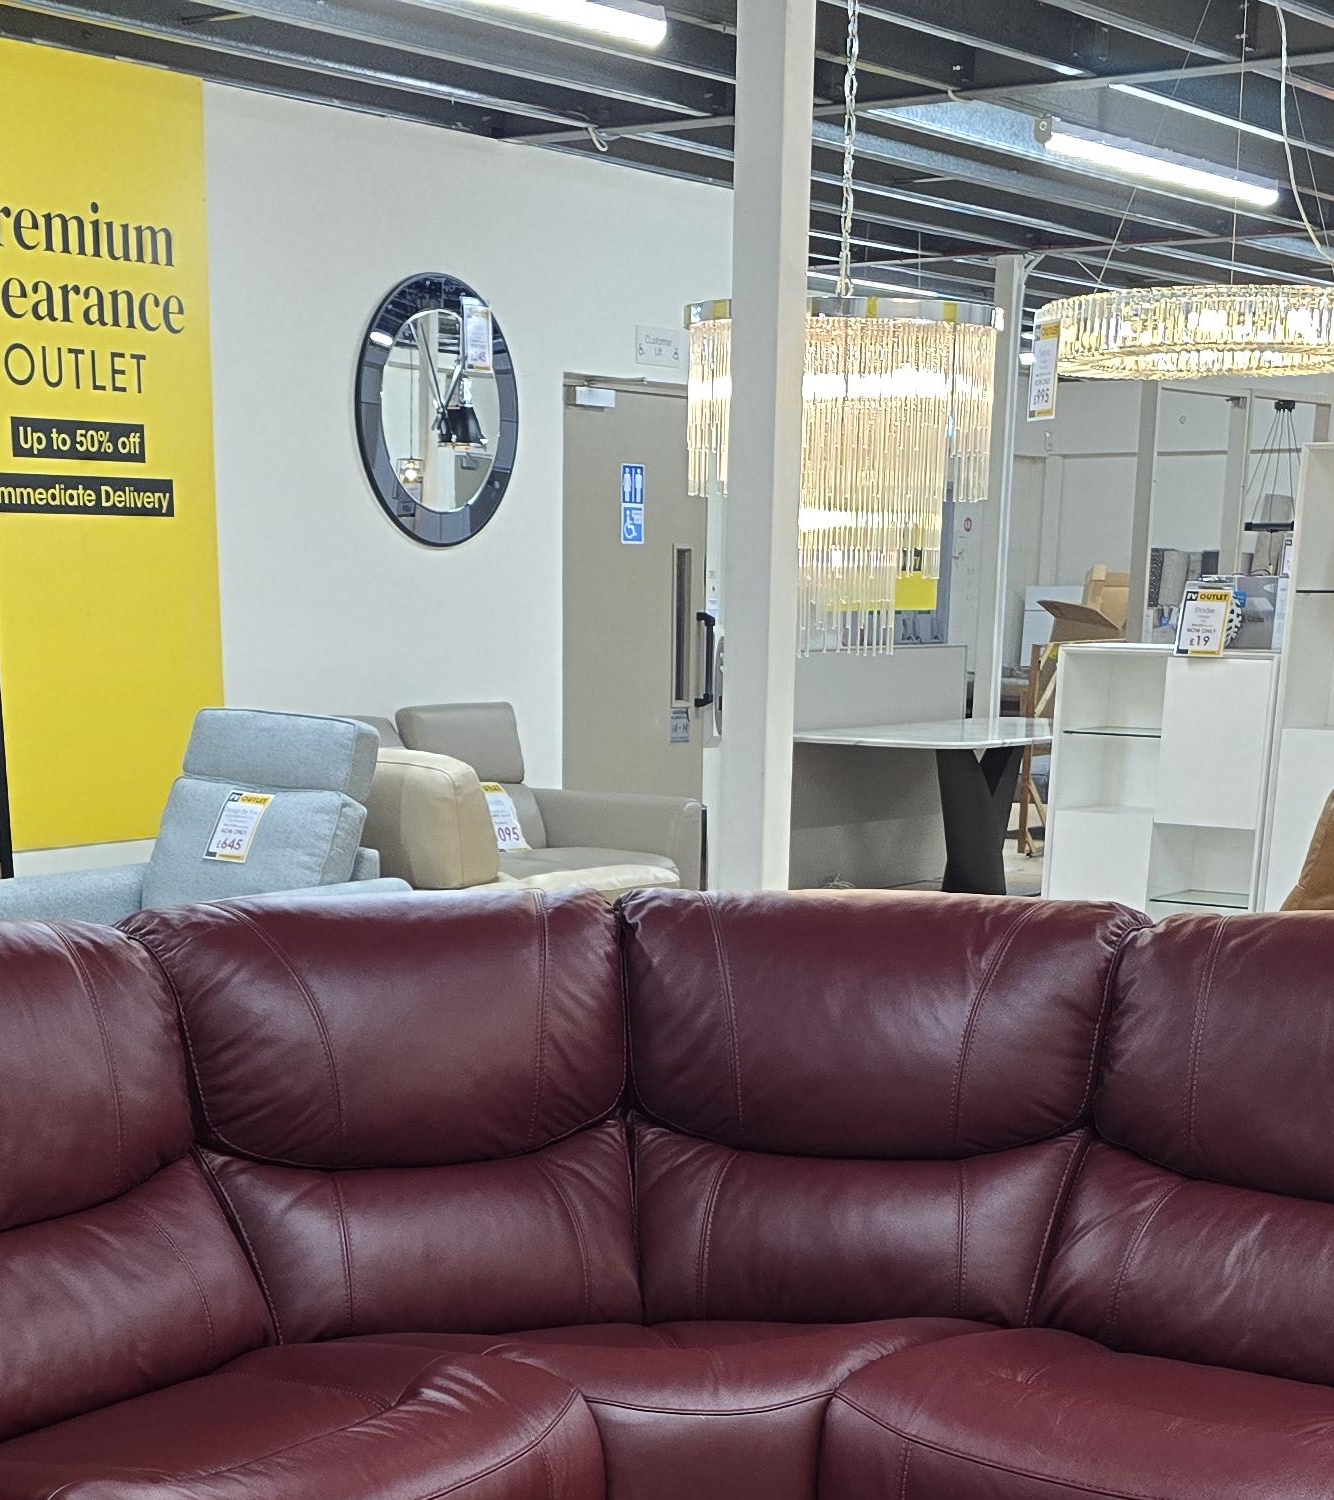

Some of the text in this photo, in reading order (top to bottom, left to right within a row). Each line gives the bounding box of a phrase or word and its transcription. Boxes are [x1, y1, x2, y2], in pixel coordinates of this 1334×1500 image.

[3, 342, 147, 395] OUTLET
[18, 426, 141, 455] Up to 50% off
[100, 485, 170, 514] Delivery
[1189, 635, 1211, 646] £19
[216, 838, 243, 851] £645
[497, 827, 520, 841] 095
